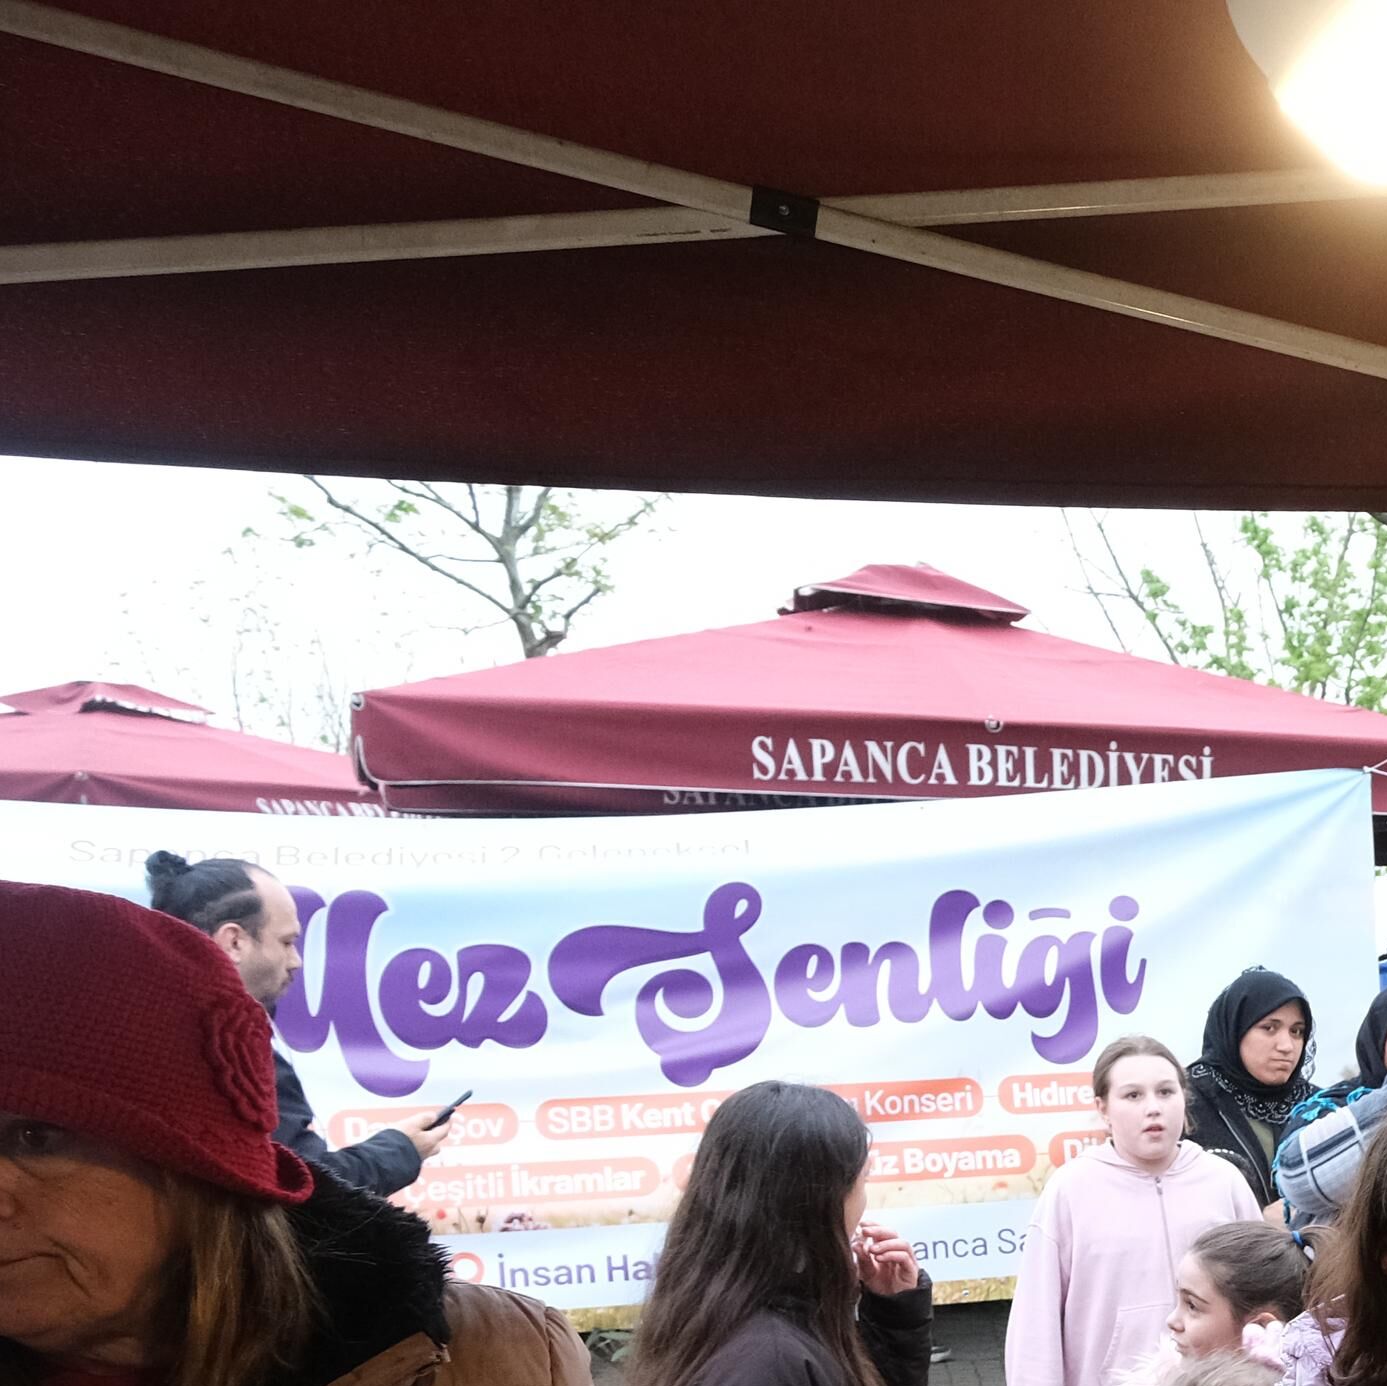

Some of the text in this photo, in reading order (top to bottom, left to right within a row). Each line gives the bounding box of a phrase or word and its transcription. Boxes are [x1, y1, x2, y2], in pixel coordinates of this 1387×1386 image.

[751, 736, 1214, 789] SAPANCA BELEDİYESİ
[69, 840, 259, 868] Sapnca
[447, 1111, 505, 1145] Şov
[547, 1103, 614, 1135] SBB
[621, 1100, 696, 1131] Kent
[864, 1085, 973, 1116] Konseri
[1012, 1081, 1093, 1108] Hıdıre
[402, 1171, 504, 1206] Çeşitli
[512, 1163, 647, 1195] İkramlar
[904, 1146, 1021, 1178] Boyama
[497, 1252, 595, 1288] İnsan
[606, 1253, 660, 1282] Ha
[912, 1236, 988, 1261] anca
